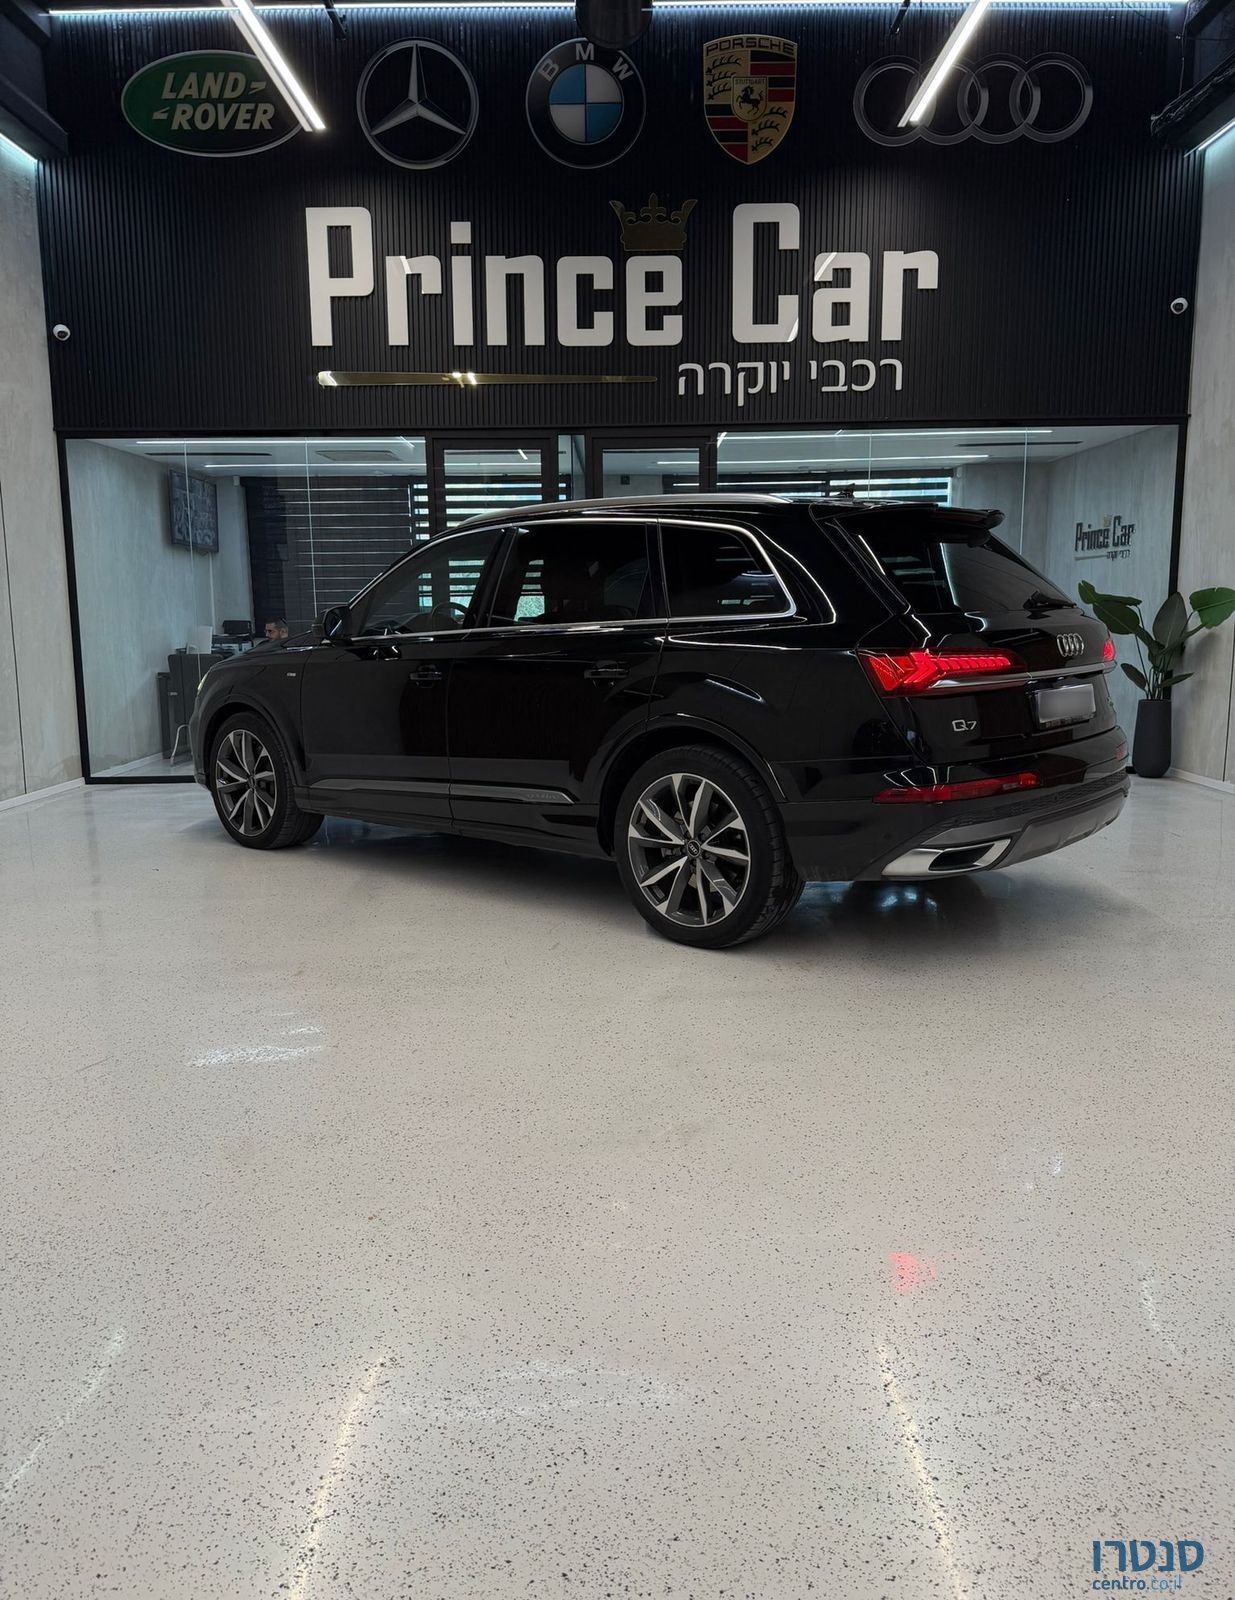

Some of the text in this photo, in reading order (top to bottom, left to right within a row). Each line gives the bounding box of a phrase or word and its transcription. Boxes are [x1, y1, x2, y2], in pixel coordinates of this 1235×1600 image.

[537, 43, 634, 81] BMW
[705, 37, 796, 56] PORSCHE
[161, 71, 247, 99] LAND
[171, 103, 275, 130] ROVER
[305, 202, 940, 347] Prince Car
[678, 358, 904, 407] רכבי יוקרה
[1075, 515, 1135, 551] Prince Car
[952, 719, 977, 732] Q7
